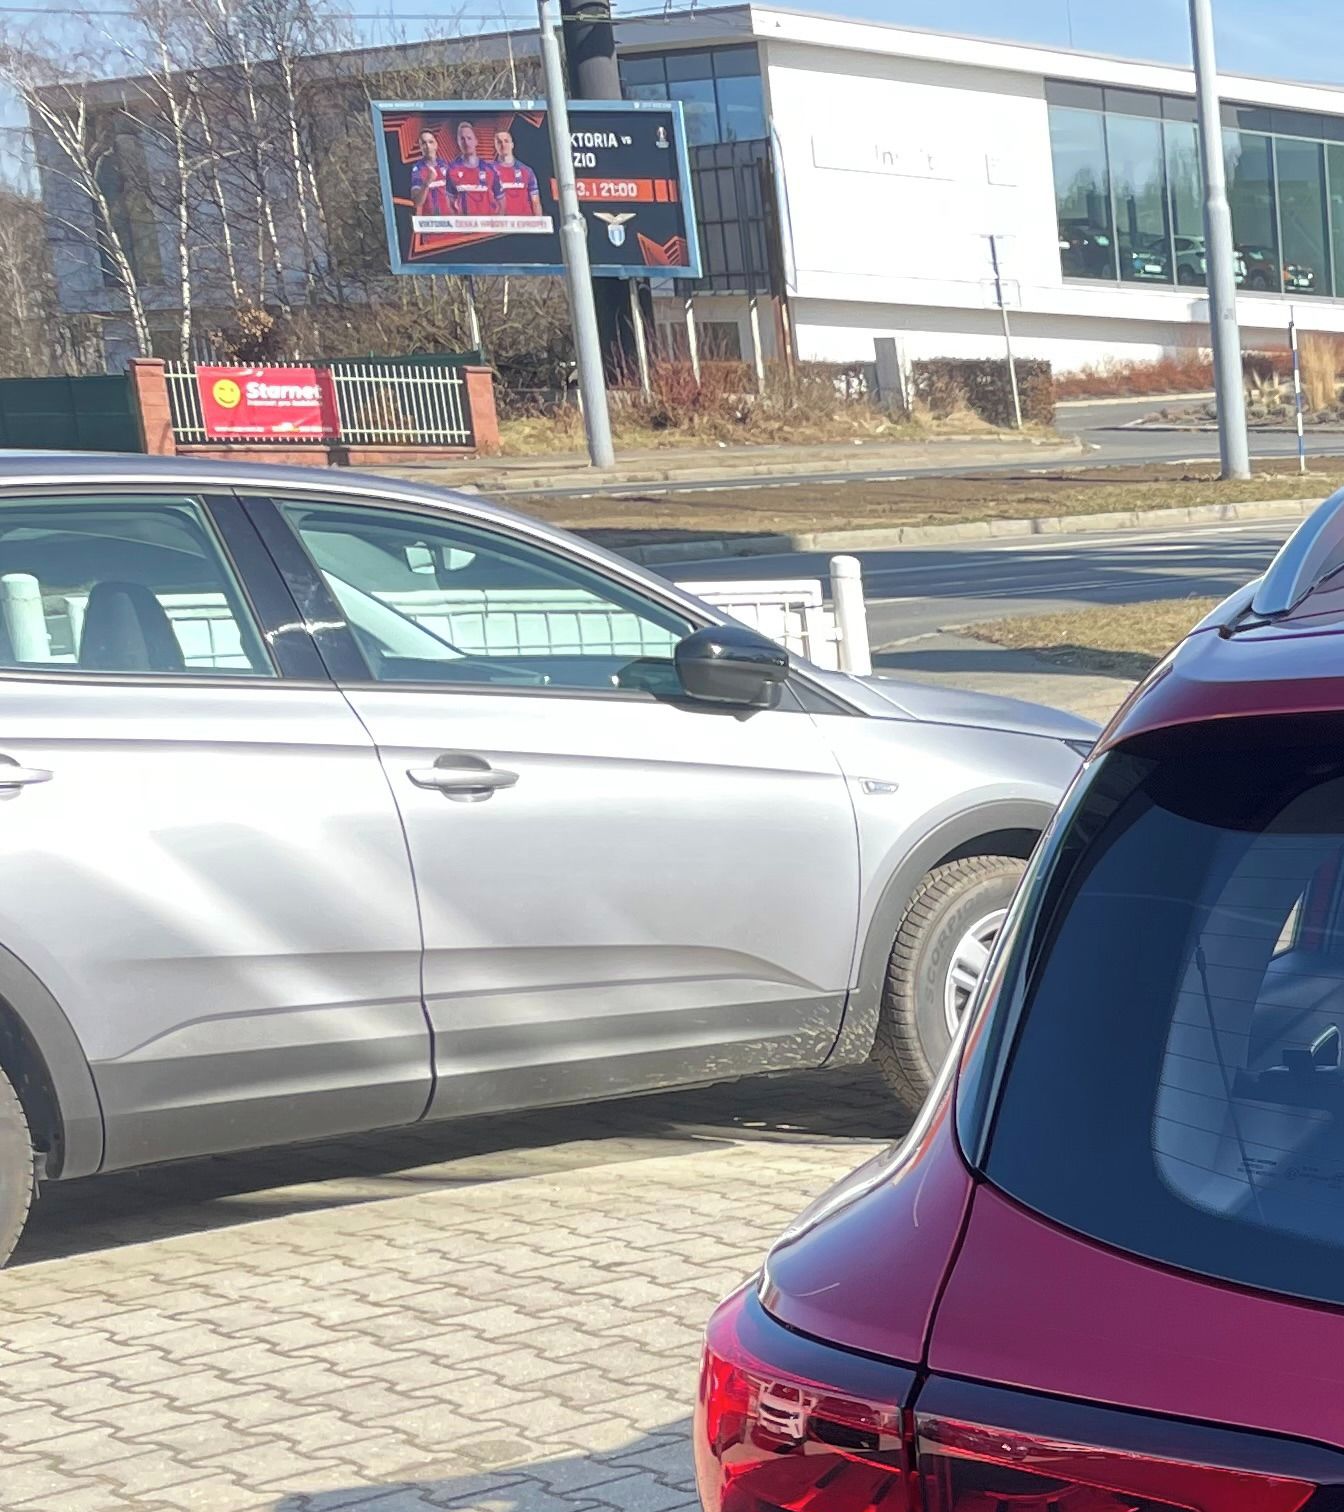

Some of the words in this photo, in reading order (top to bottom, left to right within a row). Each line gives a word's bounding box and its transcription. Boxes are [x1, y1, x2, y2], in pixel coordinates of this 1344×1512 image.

[567, 132, 618, 148] KTORIA
[573, 152, 596, 168] ZIO
[600, 182, 637, 197] 21:00
[245, 382, 322, 399] Starnet
